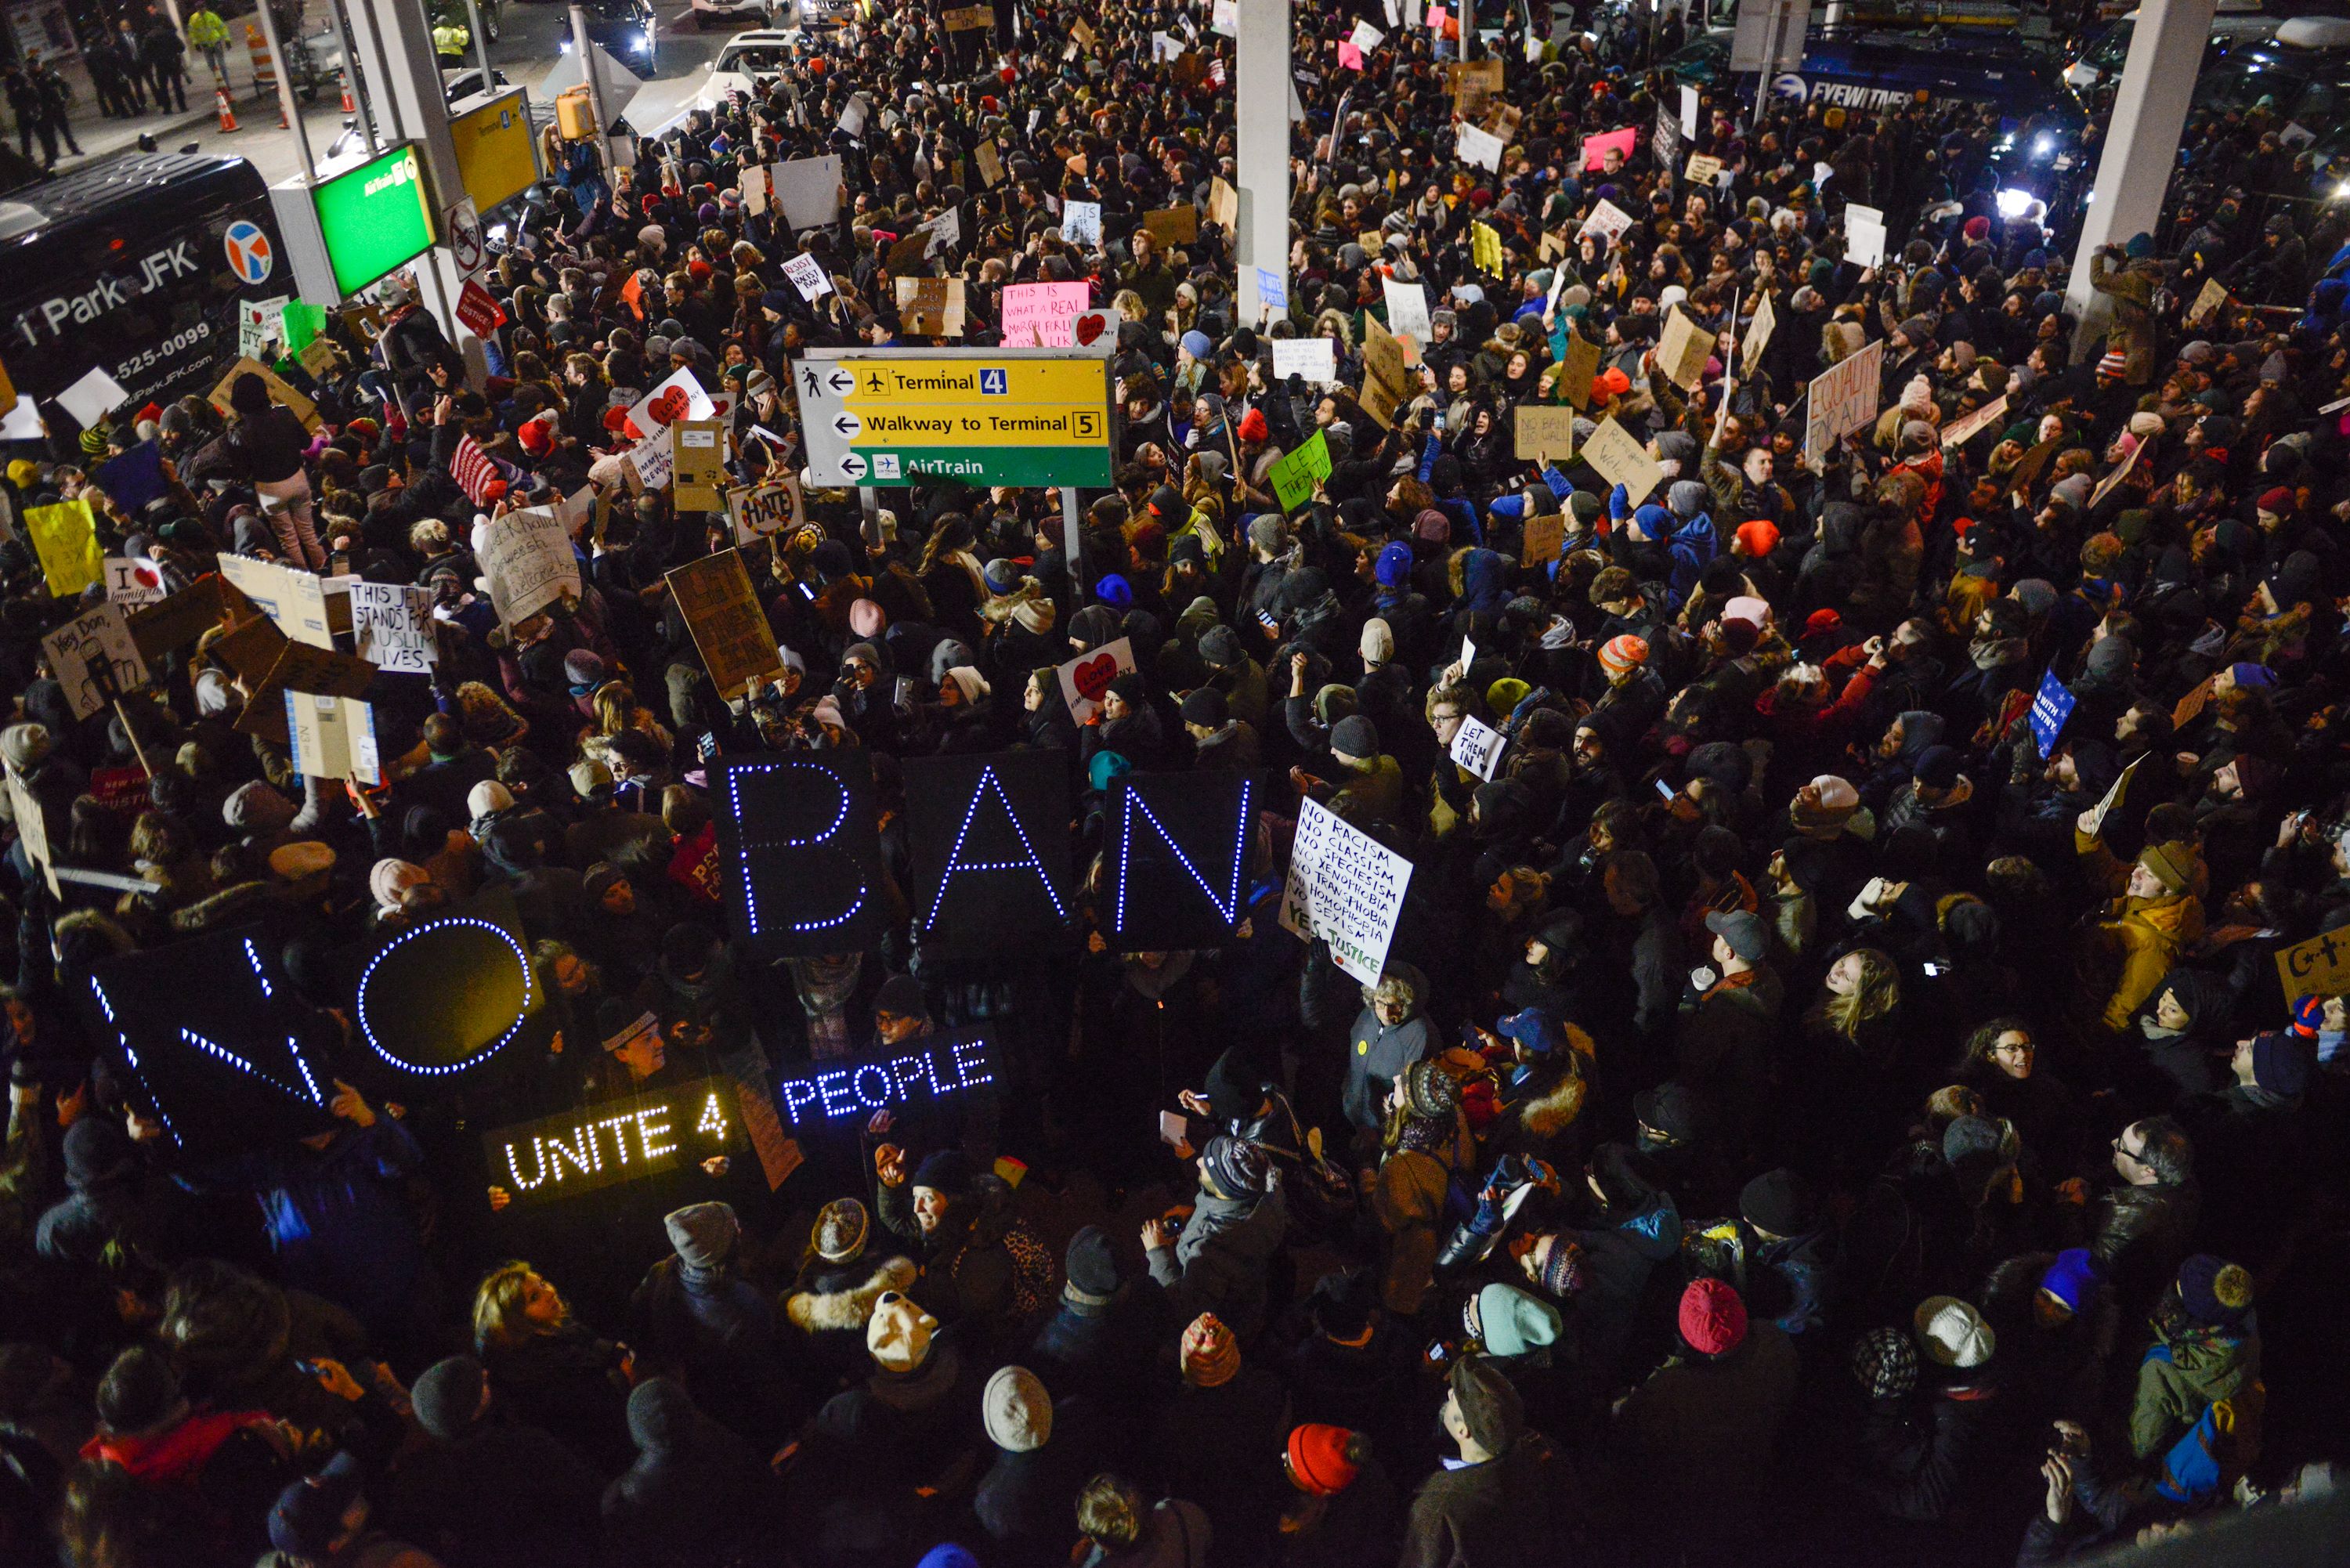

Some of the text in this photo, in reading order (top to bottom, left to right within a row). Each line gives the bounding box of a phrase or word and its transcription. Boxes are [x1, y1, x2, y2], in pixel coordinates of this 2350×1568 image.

[364, 172, 395, 197] AirTrain
[783, 257, 811, 275] RESIST
[794, 269, 819, 287] RACIST
[16, 240, 200, 347] i Park JFK
[803, 278, 819, 290] BAN
[1008, 285, 1058, 300] THIS IS
[244, 308, 251, 322] I
[1005, 298, 1084, 317] WHAT A REAL
[244, 330, 262, 348] NY
[1049, 334, 1072, 348] LIK
[895, 371, 1003, 393] Terminal 4
[1811, 349, 1881, 420] EQUALITY
[662, 390, 684, 418] LOVE
[866, 415, 1094, 434] Walkway to Terminal 5
[1520, 417, 1536, 431] NO
[1810, 409, 1838, 456] FOR
[1840, 391, 1875, 435] ALL
[1542, 431, 1570, 443] WALL
[906, 459, 983, 474] AirTrain
[1285, 440, 1316, 476] LET
[1599, 443, 1637, 491] Welcome
[1280, 469, 1314, 499] THEM
[748, 492, 790, 523] HATE
[115, 567, 132, 590] I
[687, 559, 750, 612] LET
[351, 585, 432, 611] THIS JEW
[356, 608, 432, 633] STANDS FOR
[52, 630, 79, 659] Hey
[359, 630, 438, 651] MUSLIM
[371, 651, 425, 670] LIVES
[2040, 695, 2059, 717] WITH
[1463, 723, 1485, 740] LET
[1459, 737, 1488, 761] THEM
[1459, 751, 1474, 768] IN
[1303, 802, 1390, 867] NO RACISM
[728, 761, 1252, 935] BAN
[1300, 817, 1394, 885] NO CLASSISM
[1294, 843, 1389, 913] NO XENOPHOBIA
[1298, 830, 1396, 903] NO SPECIESISM
[1289, 869, 1383, 944] NO HOMOPHOBIA
[1292, 858, 1388, 930] NO TRANSPHOBIA
[1287, 881, 1365, 944] NO SEXISM
[1289, 901, 1380, 974] YES JUSTICE
[783, 1039, 994, 1124] PEOPLE
[505, 1093, 728, 1190] UNITE 4
